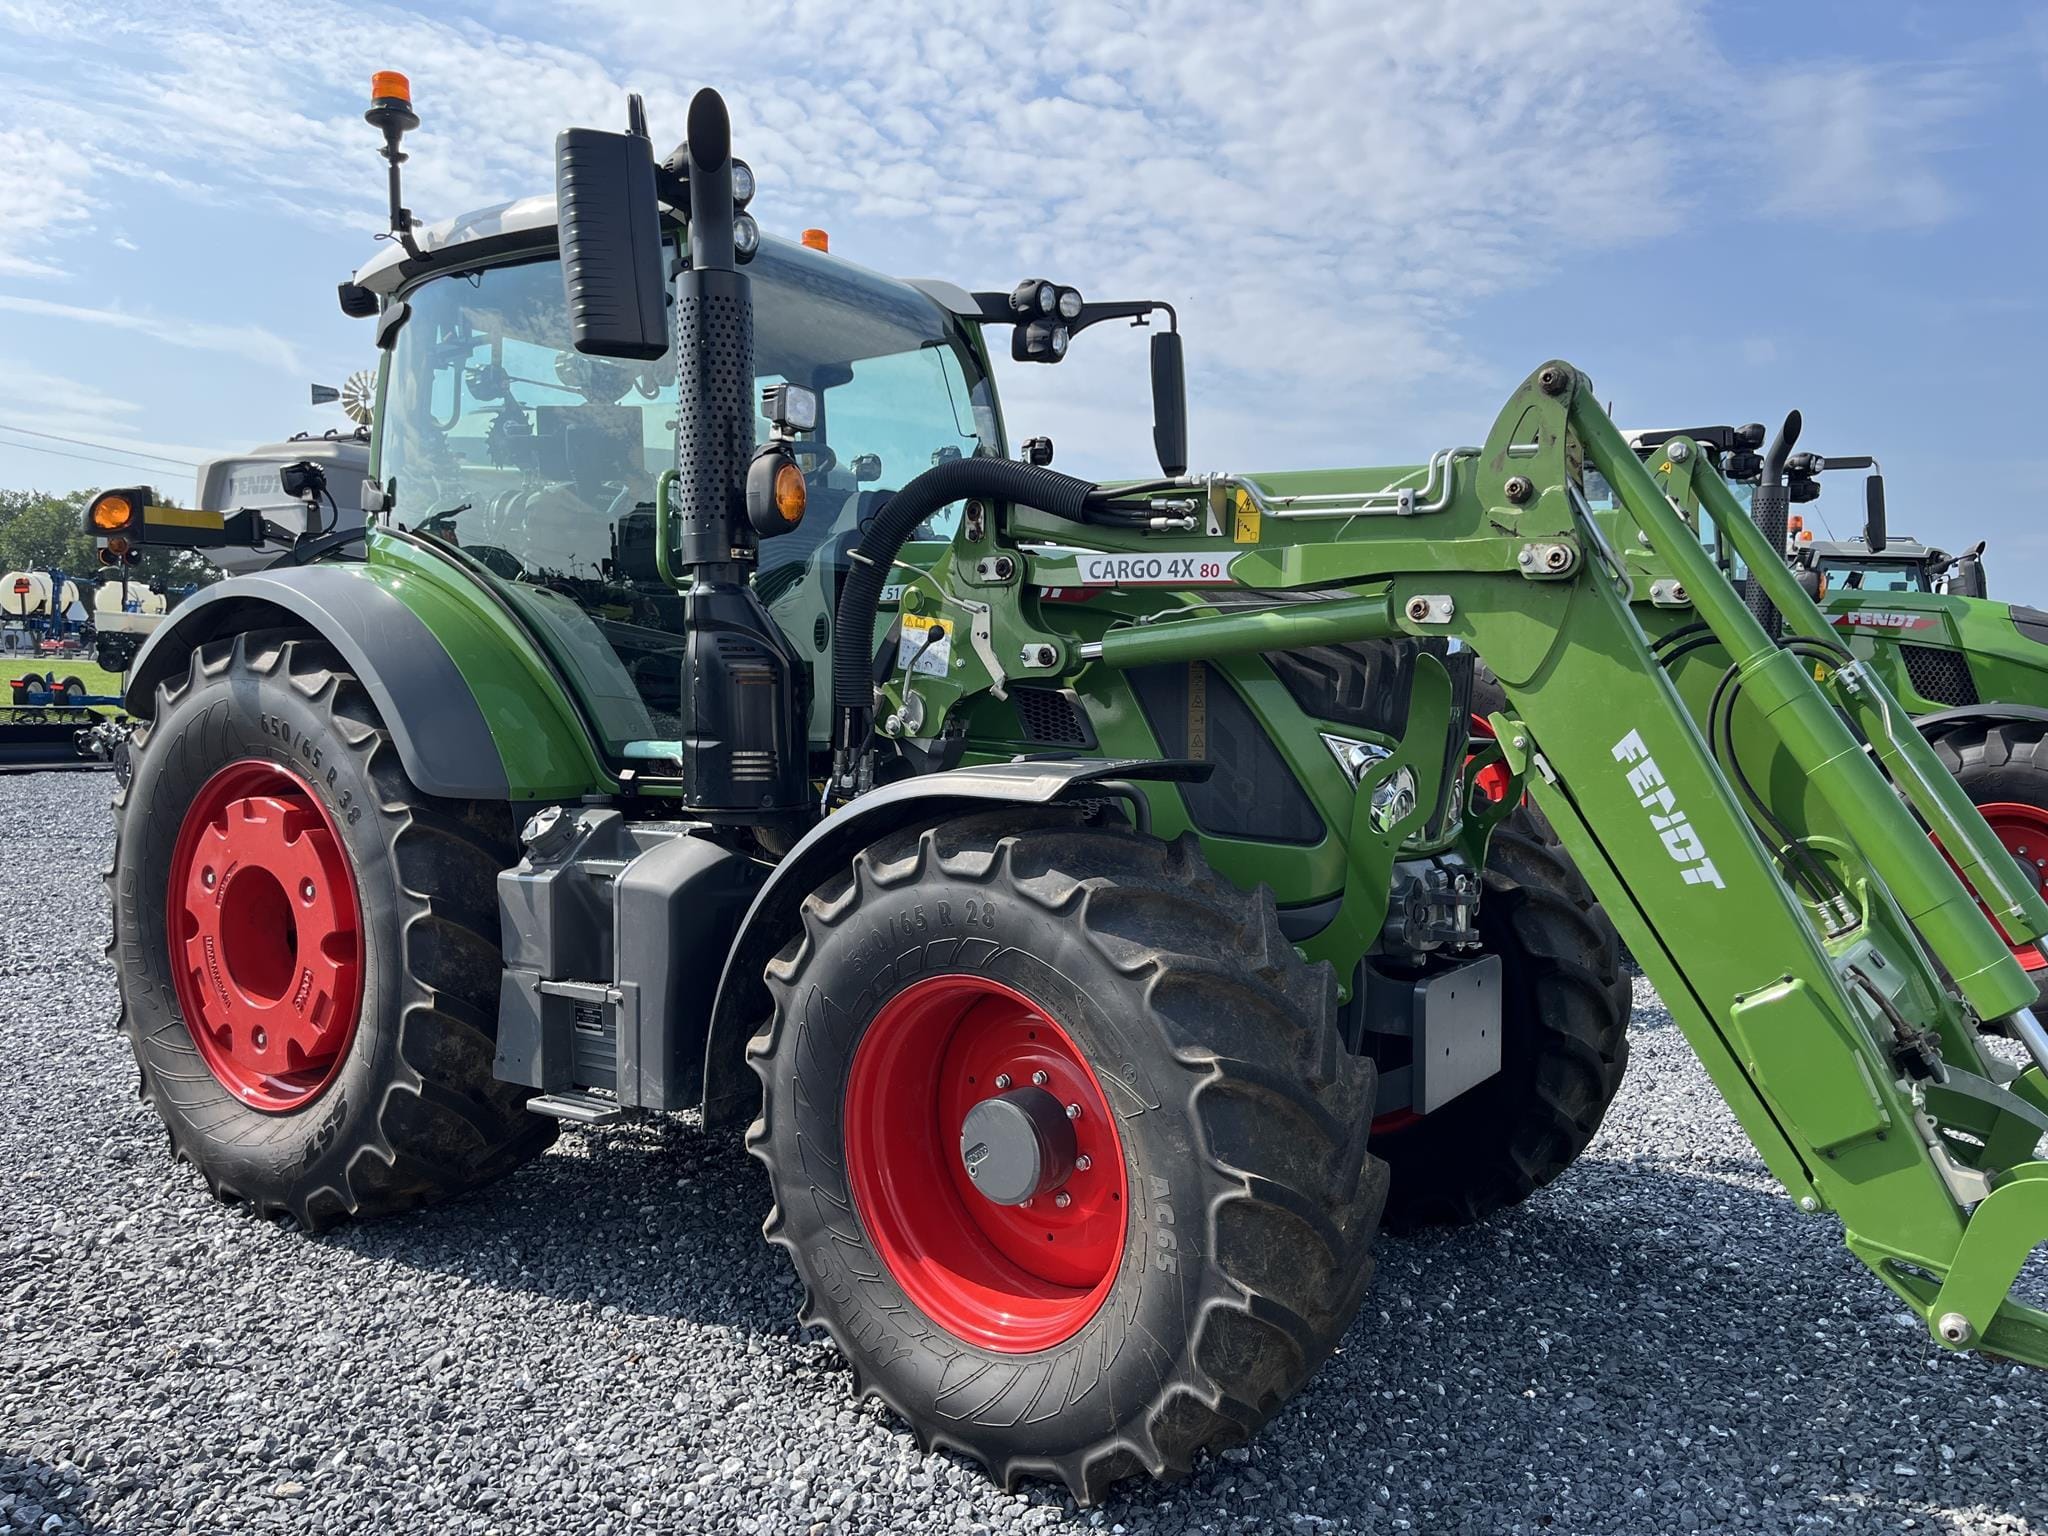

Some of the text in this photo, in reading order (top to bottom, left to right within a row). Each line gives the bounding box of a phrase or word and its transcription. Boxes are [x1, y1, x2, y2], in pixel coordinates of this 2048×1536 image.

[1089, 558, 1220, 579] CARGO 4X 80
[1847, 611, 1921, 628] FENDT
[261, 711, 362, 825] 650/65 R 38
[1611, 728, 1726, 889] FENDT
[937, 900, 953, 926] R
[965, 899, 995, 929] 28
[1149, 1174, 1178, 1275] AC65
